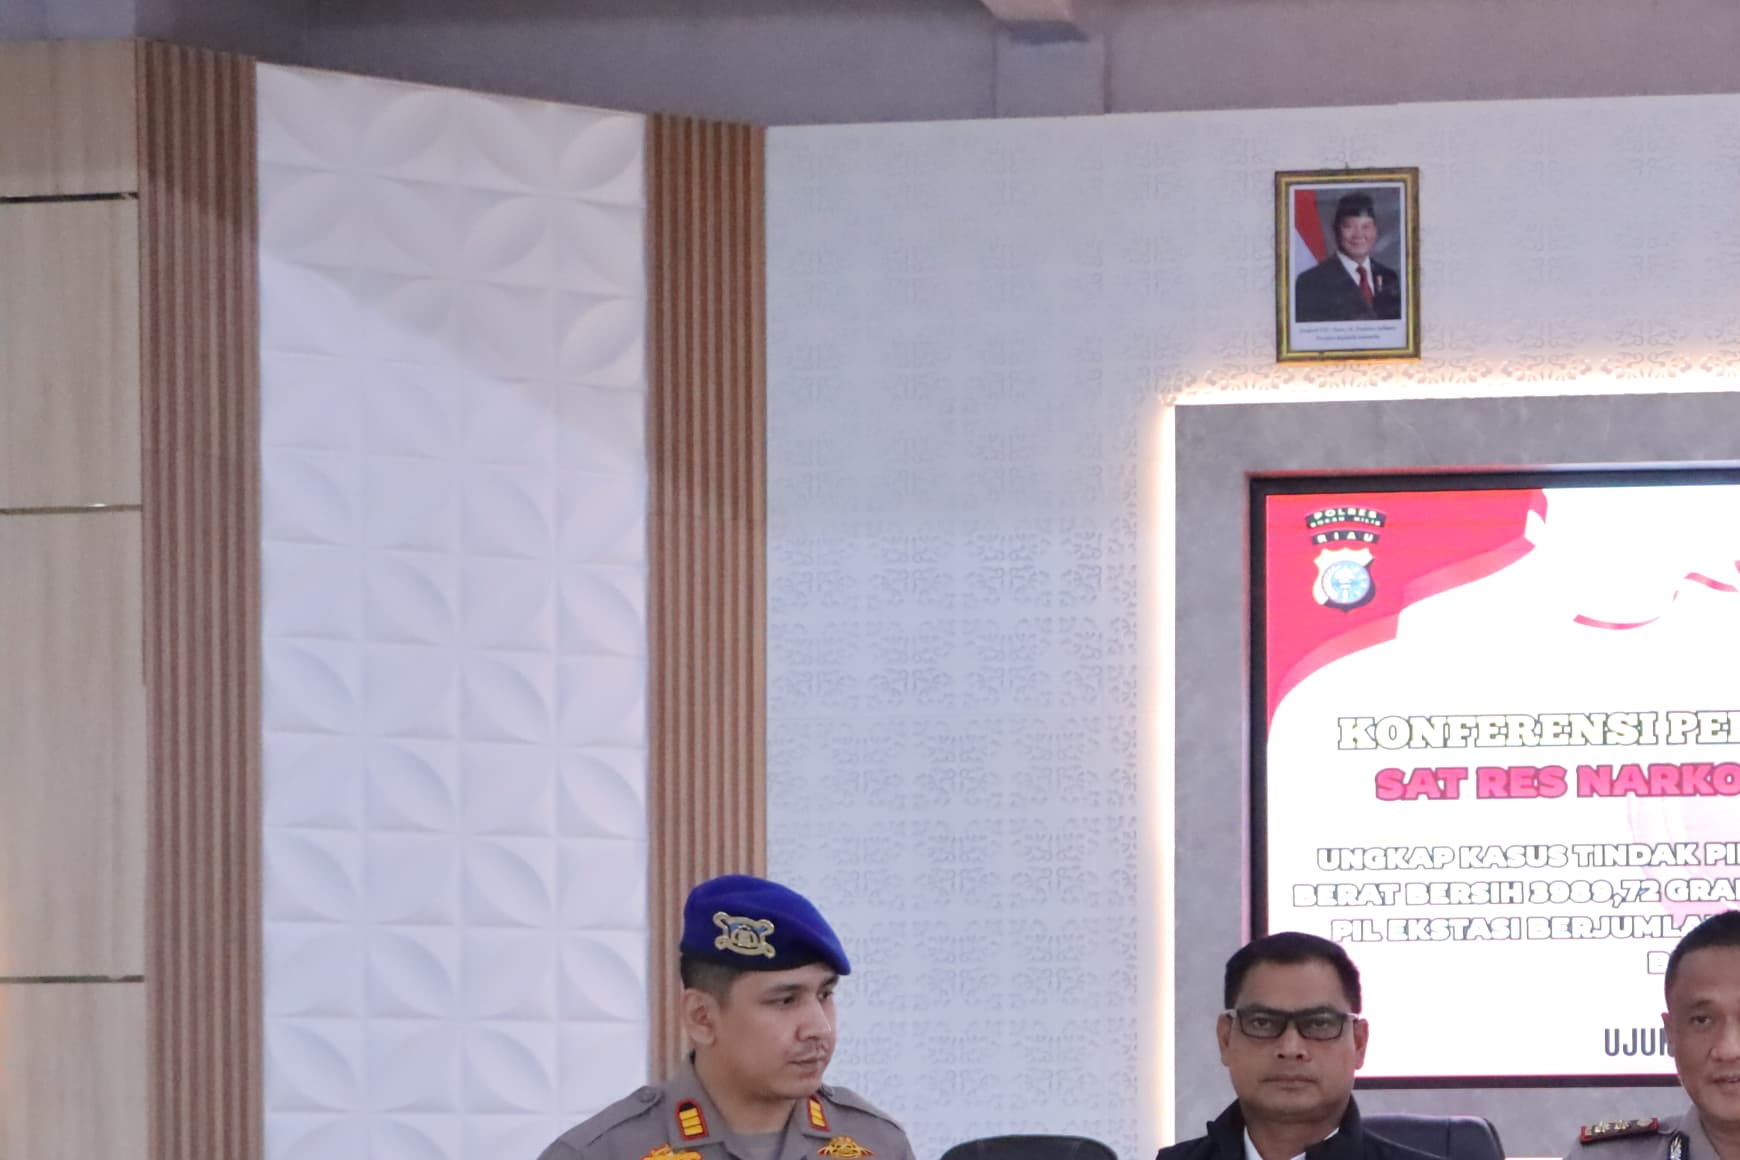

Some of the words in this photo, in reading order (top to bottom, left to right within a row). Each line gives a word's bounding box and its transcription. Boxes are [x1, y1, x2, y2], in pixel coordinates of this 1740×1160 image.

[1313, 507, 1377, 520] POLRES
[1317, 531, 1374, 544] RIAU
[1338, 711, 1659, 750] KONFERENSI
[1375, 767, 1468, 801] SAT
[1476, 766, 1568, 800] RES
[1317, 846, 1455, 871] UNGKAP
[1459, 845, 1569, 870] KASUS
[1572, 842, 1700, 868] TINDAK
[1292, 882, 1401, 908] BERAT
[1405, 881, 1525, 906] BERSIH
[1528, 879, 1662, 909] 3989,72
[1330, 918, 1383, 943] PIL
[1387, 917, 1522, 941] EKSTASI
[1527, 914, 1716, 940] BERJUMLA
